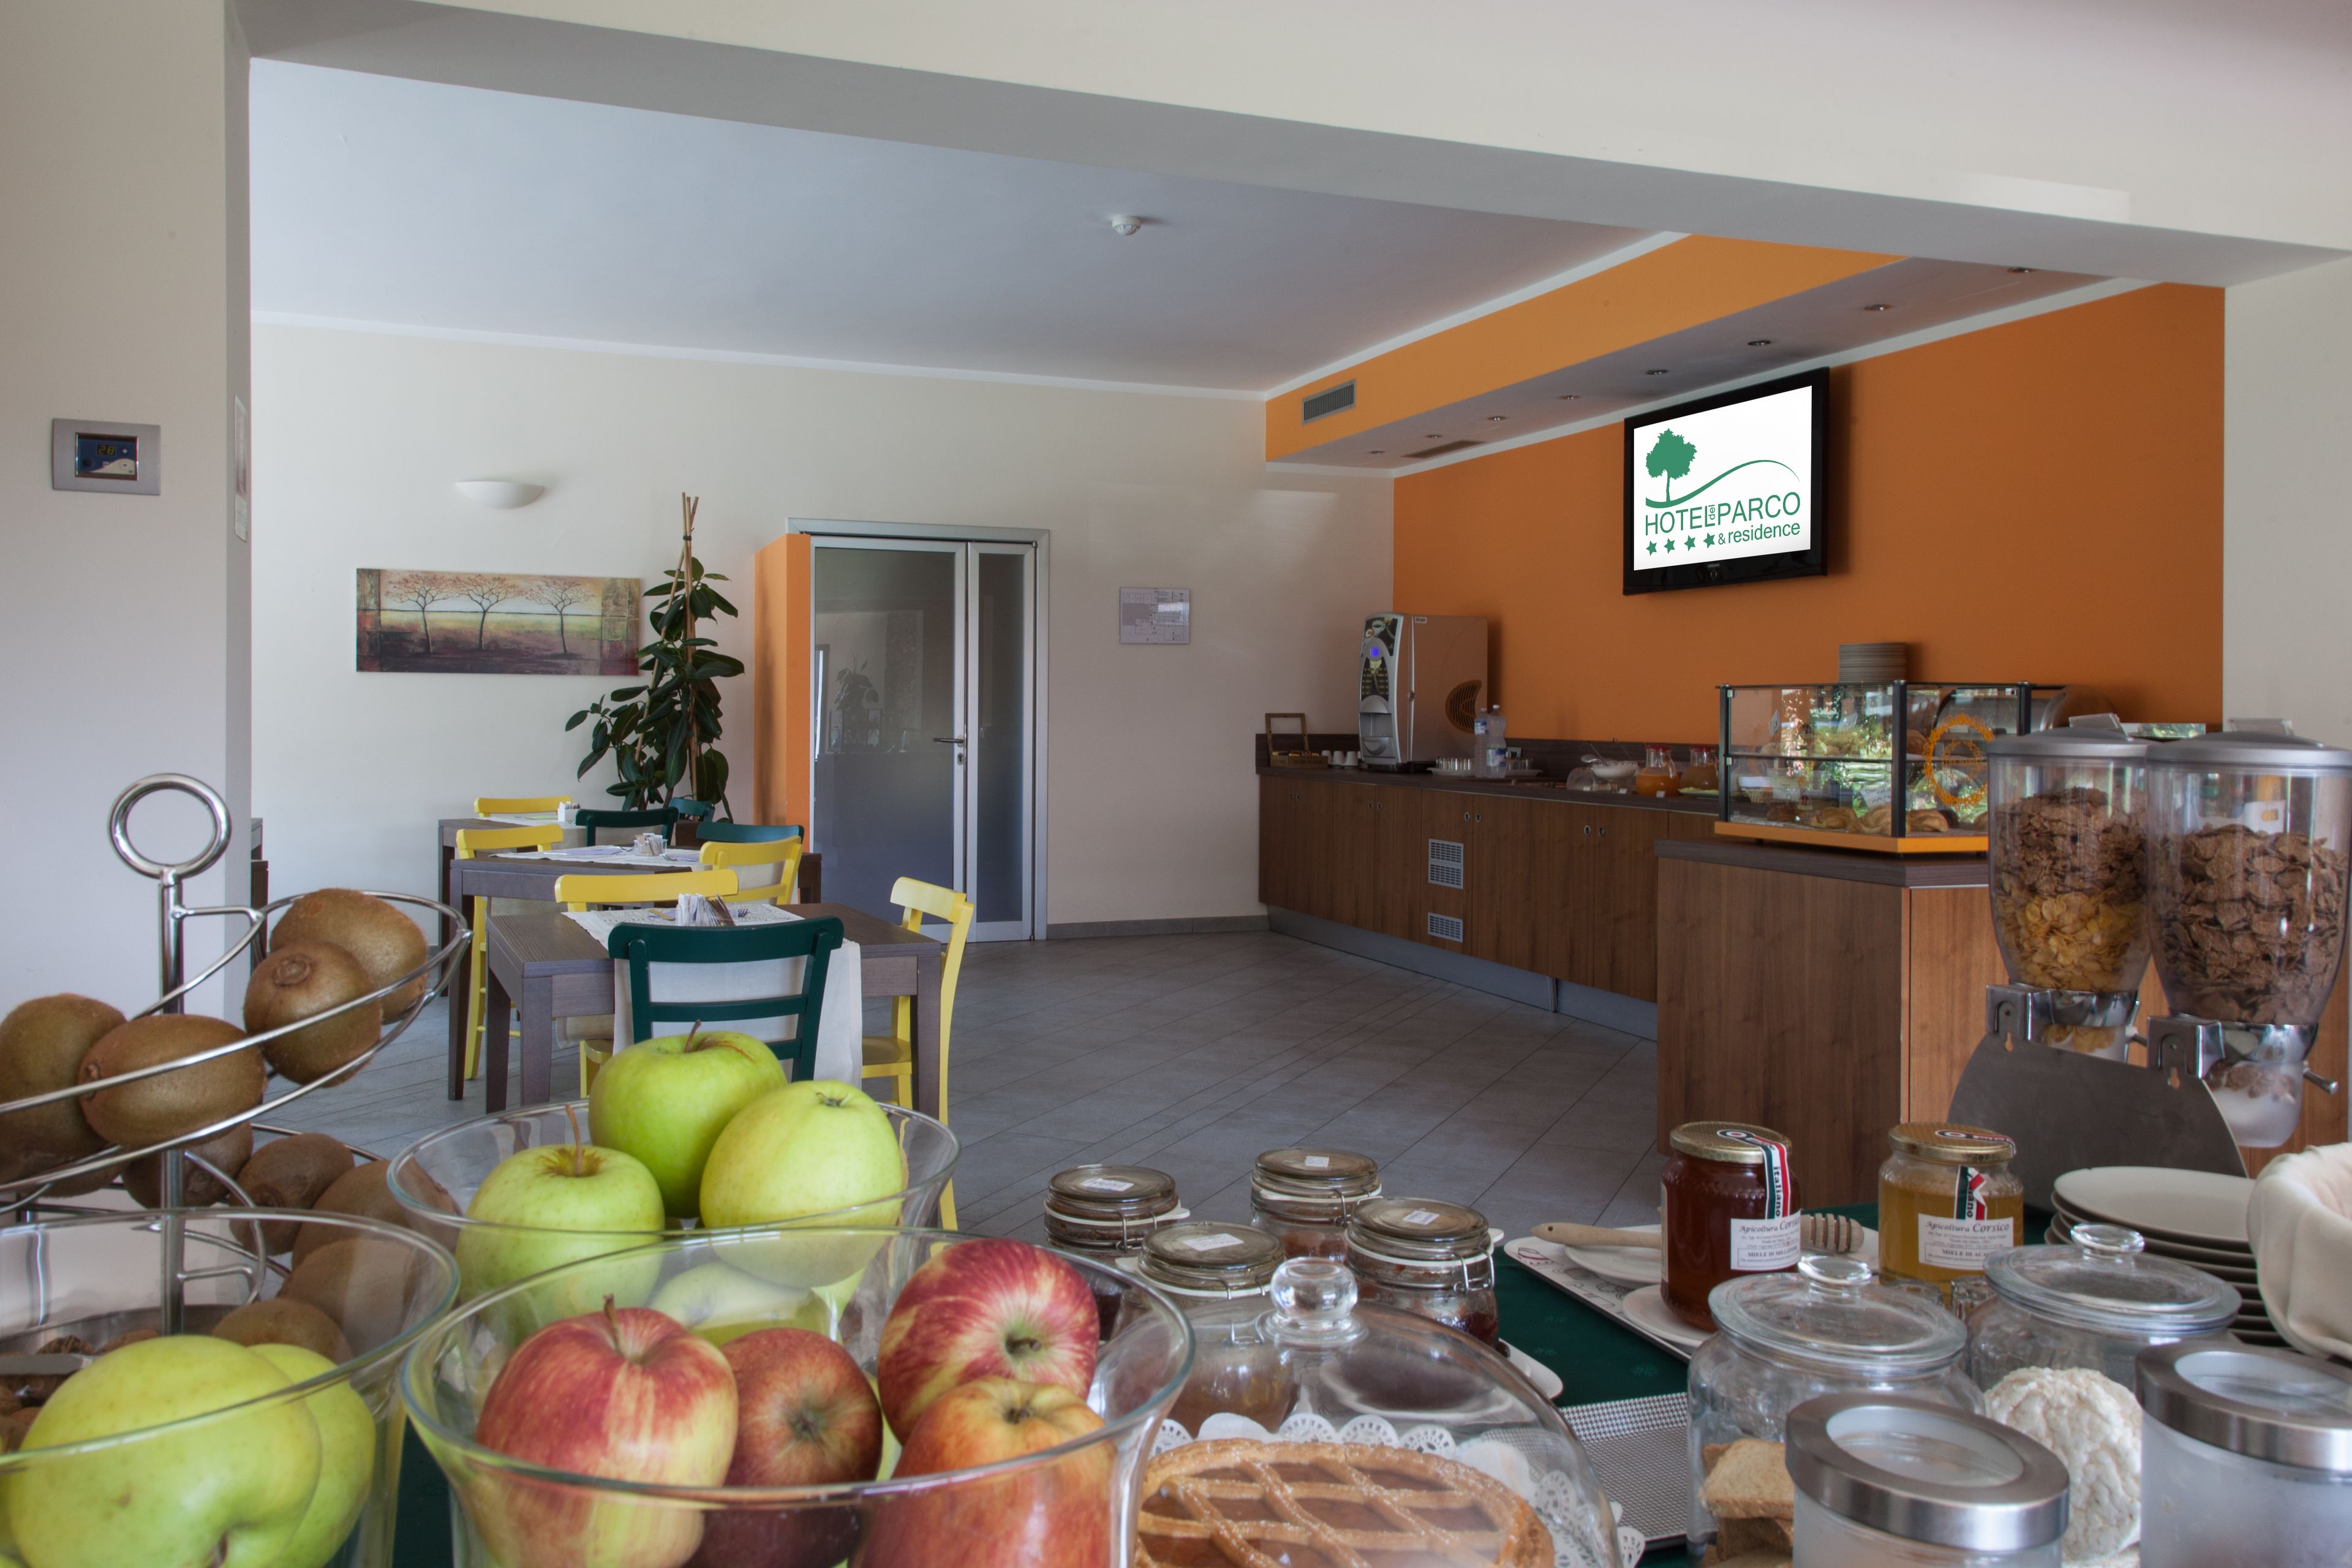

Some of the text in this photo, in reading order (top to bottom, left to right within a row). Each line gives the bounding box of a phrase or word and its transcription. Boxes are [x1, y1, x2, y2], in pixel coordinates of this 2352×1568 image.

[99, 445, 115, 455] 28
[1645, 505, 1715, 536] HOTEL
[1717, 492, 1801, 526] PARCO
[1717, 522, 1801, 545] & residence
[1773, 1166, 1782, 1217] italiano
[1738, 1224, 1778, 1234] Apicoltura
[1926, 1221, 2010, 1232] Apicoltura Corsico
